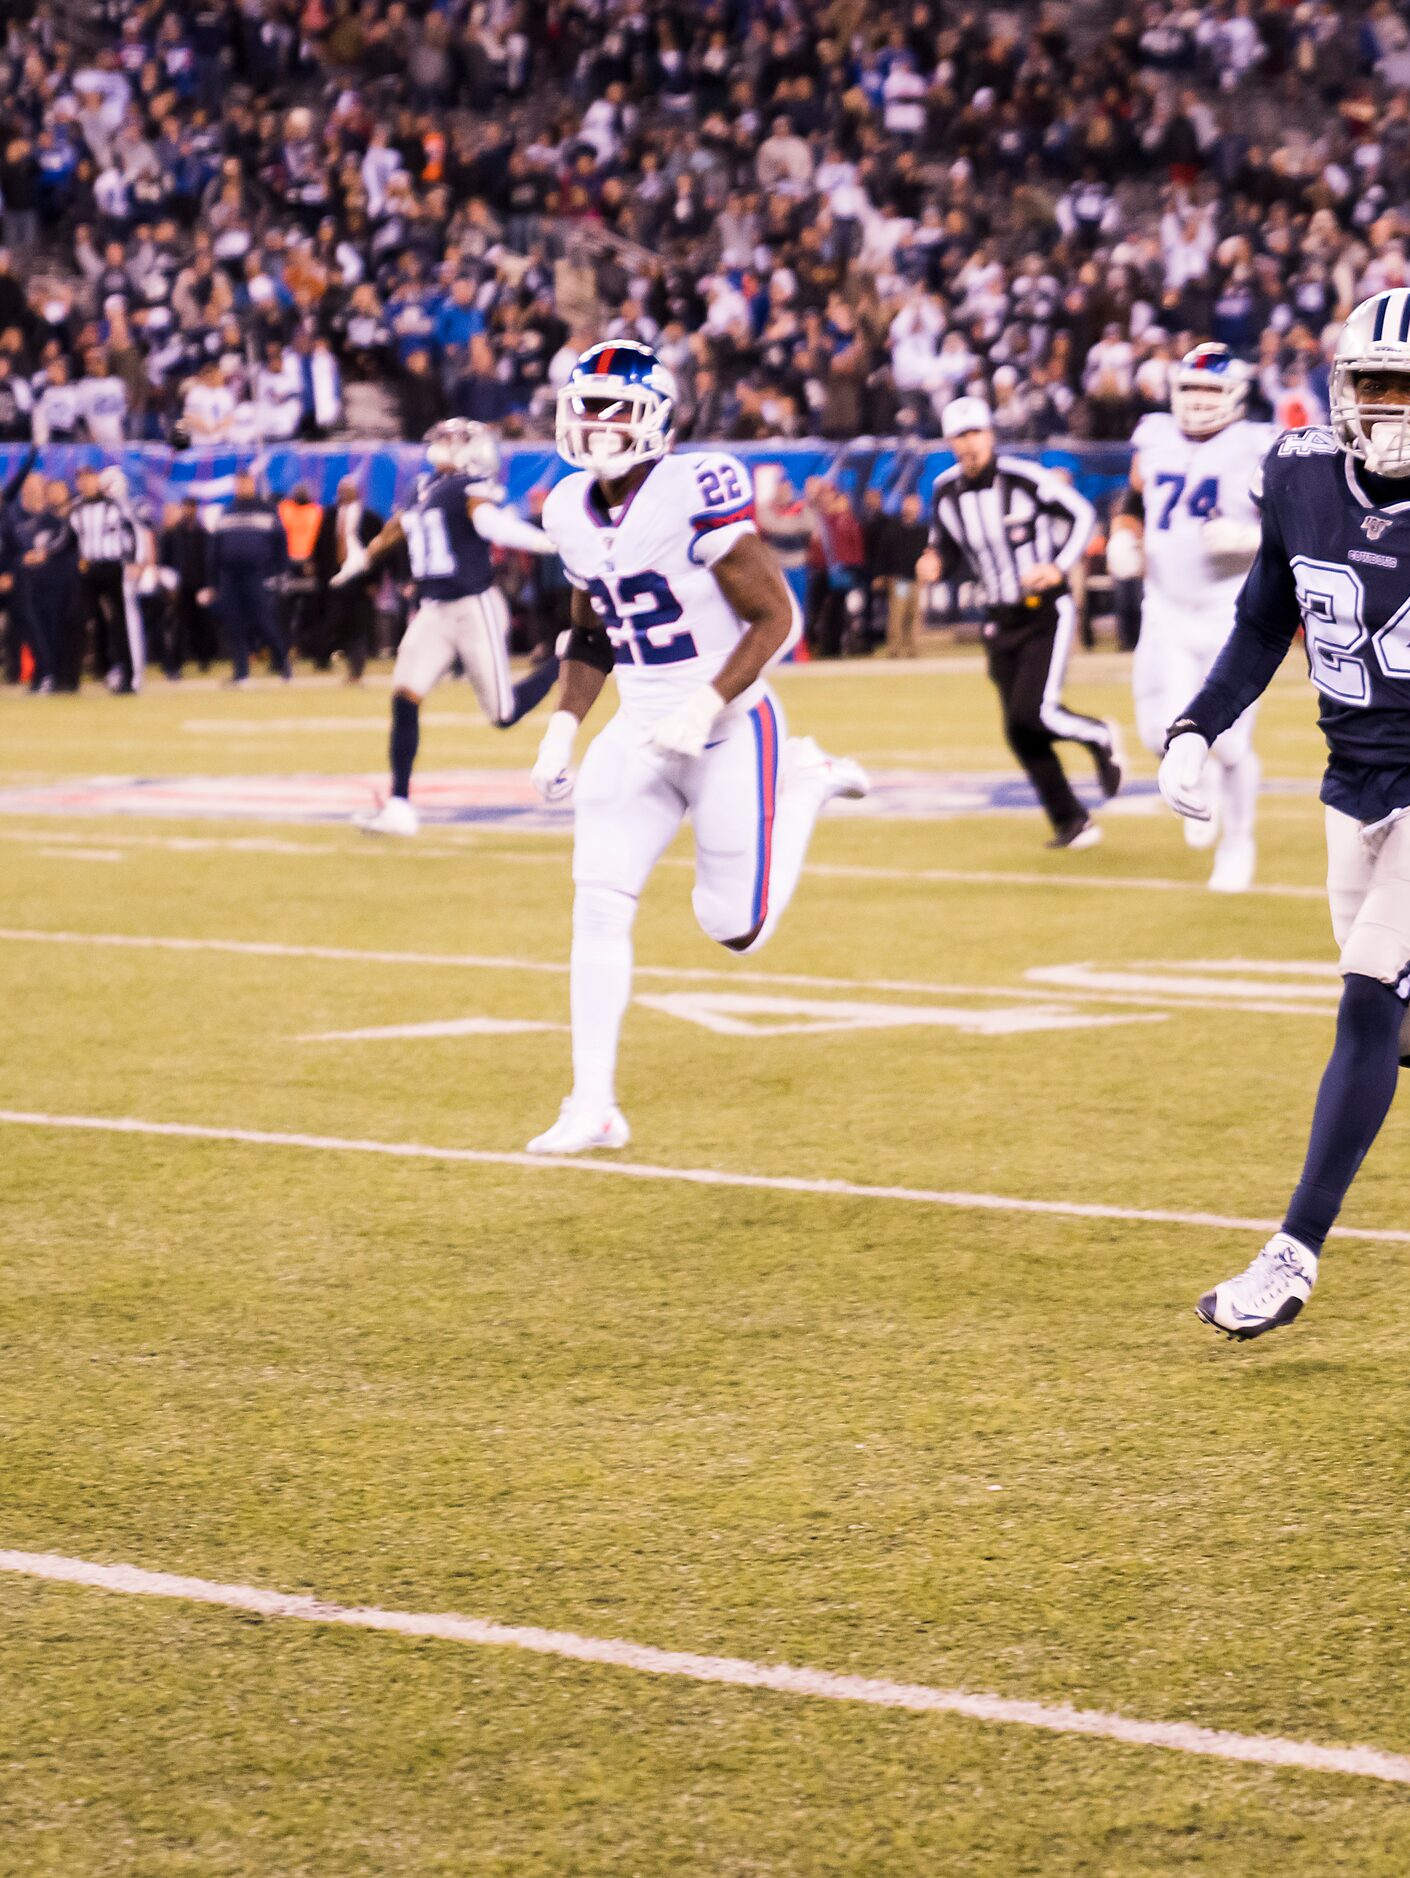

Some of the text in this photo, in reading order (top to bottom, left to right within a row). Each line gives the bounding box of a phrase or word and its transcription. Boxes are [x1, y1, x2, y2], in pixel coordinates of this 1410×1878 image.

[696, 465, 742, 507] 22
[1155, 473, 1219, 531] 74
[400, 507, 457, 578] 11
[587, 569, 699, 666] 22
